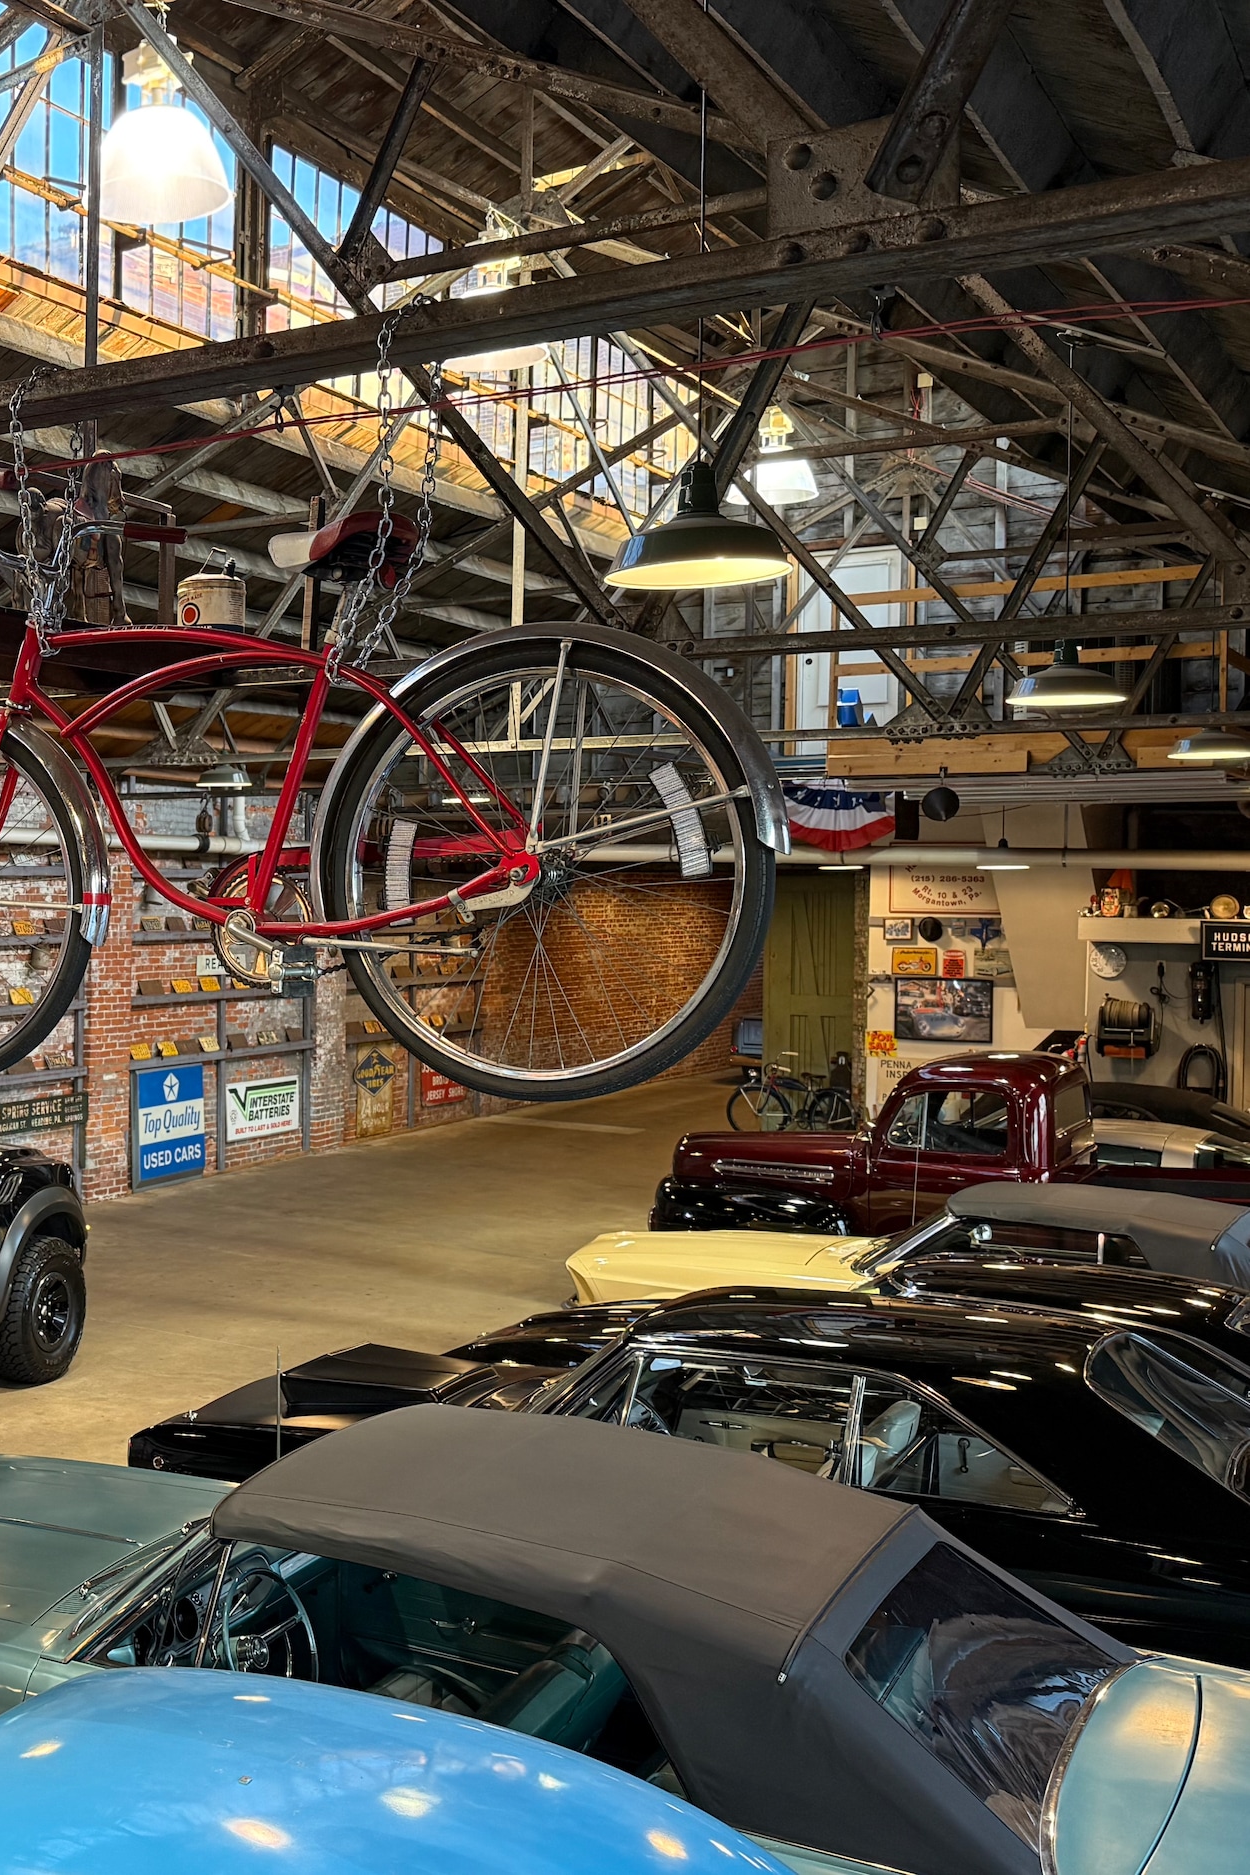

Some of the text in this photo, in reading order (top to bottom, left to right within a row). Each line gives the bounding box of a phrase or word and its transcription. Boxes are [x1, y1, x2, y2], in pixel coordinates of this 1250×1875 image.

[911, 875, 935, 883] (215)
[921, 885, 933, 896] Rt.
[962, 885, 973, 896] 23
[912, 887, 982, 907] Morgantown, Pa.
[870, 1033, 893, 1042] FOR
[868, 1042, 896, 1052] SALE
[880, 1059, 912, 1069] PENNA
[356, 1064, 395, 1079] GOODYEAR
[366, 1078, 384, 1089] TIRES
[249, 1092, 295, 1109] INTERSTATE
[426, 1089, 446, 1101] JERSEY
[1, 1103, 30, 1120] SPRING
[31, 1099, 62, 1116] SERVICE
[248, 1105, 290, 1121] BATTERIES
[143, 1112, 161, 1138] Top
[163, 1105, 201, 1133] Quality
[235, 1127, 247, 1135] BUILT
[255, 1124, 265, 1132] LAST
[143, 1143, 202, 1170] USED CARS
